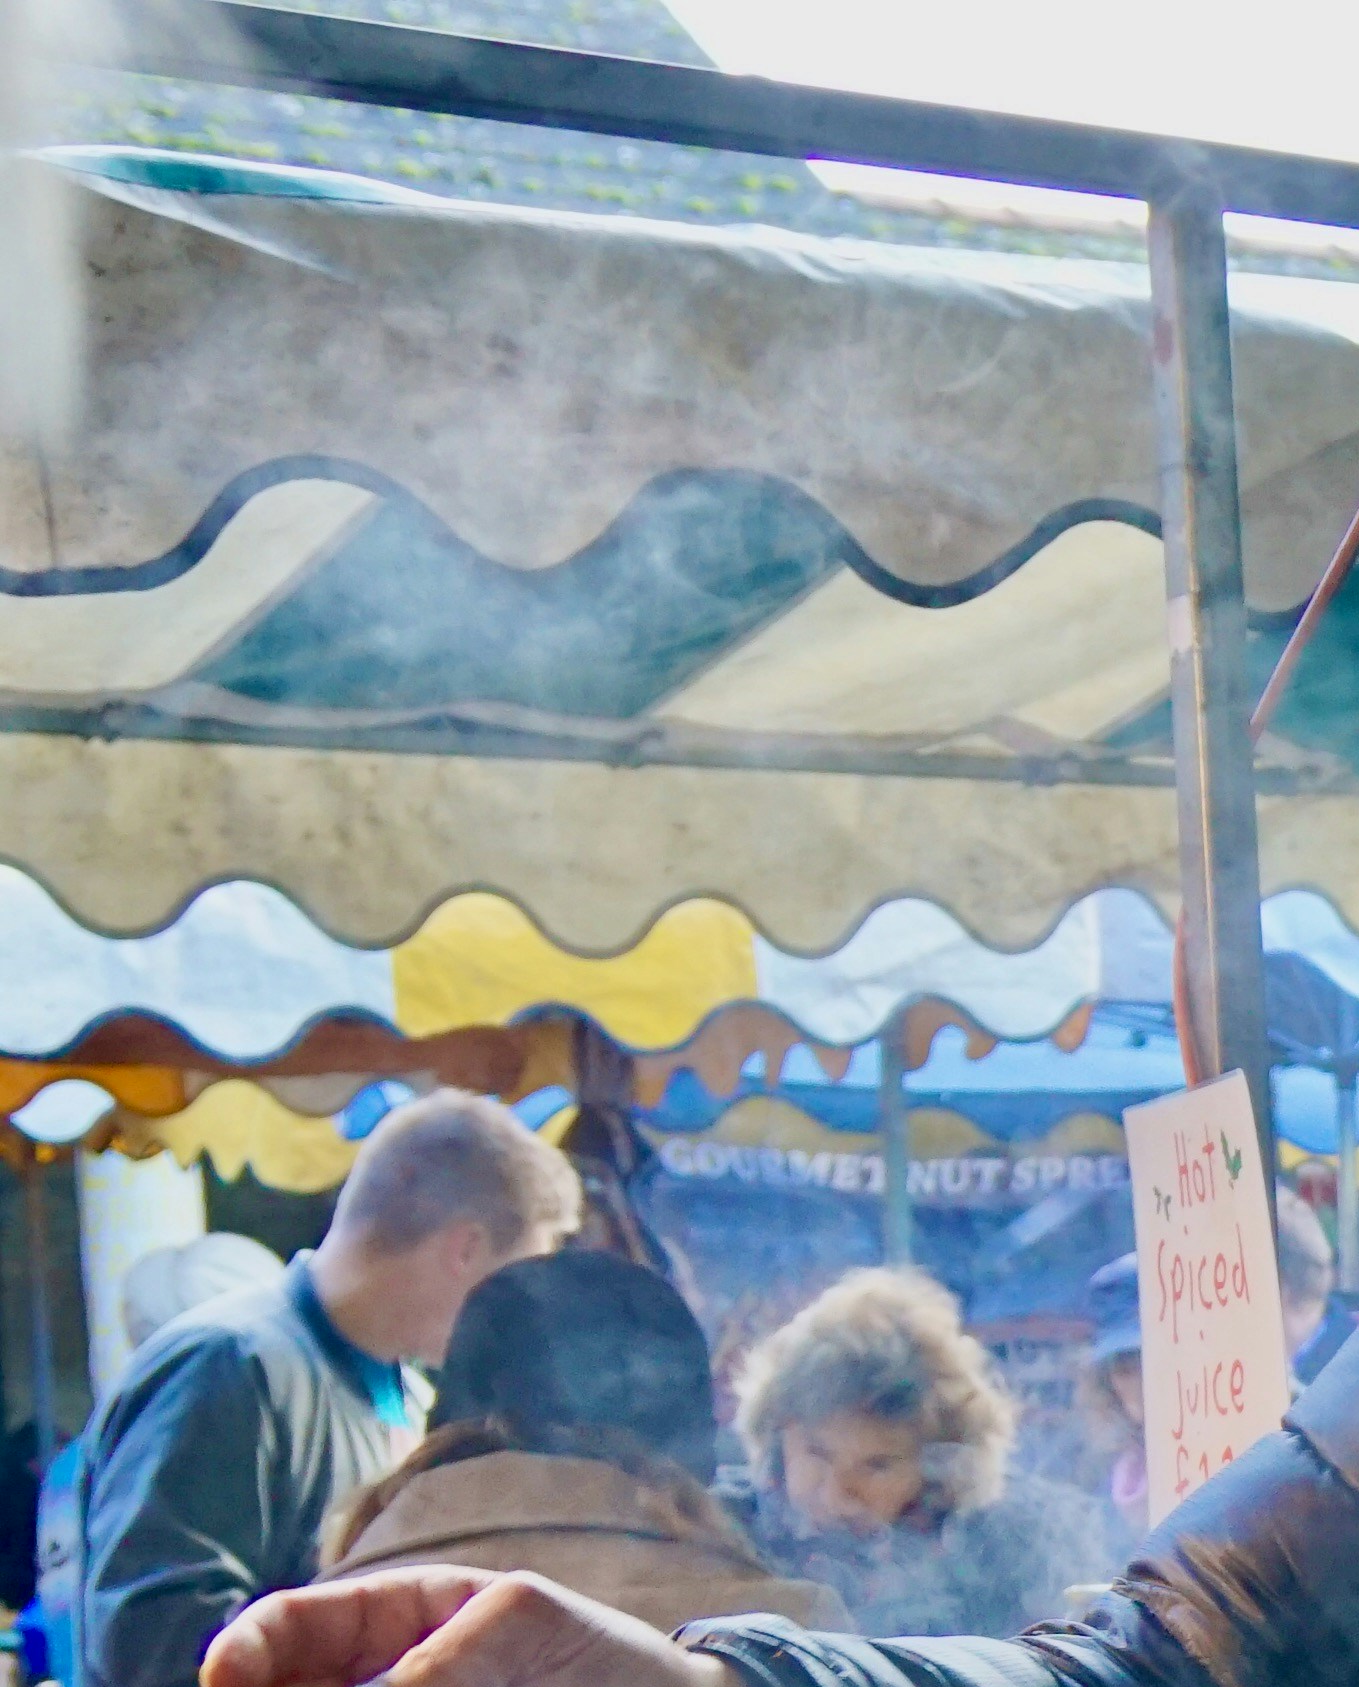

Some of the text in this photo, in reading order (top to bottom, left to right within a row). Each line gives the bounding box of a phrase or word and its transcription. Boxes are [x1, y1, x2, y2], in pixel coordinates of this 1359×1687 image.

[906, 1156, 1004, 1194] NUT
[1009, 1154, 1131, 1194] SPRE
[1174, 1124, 1217, 1207] Hot
[1157, 1223, 1250, 1343] Spiced
